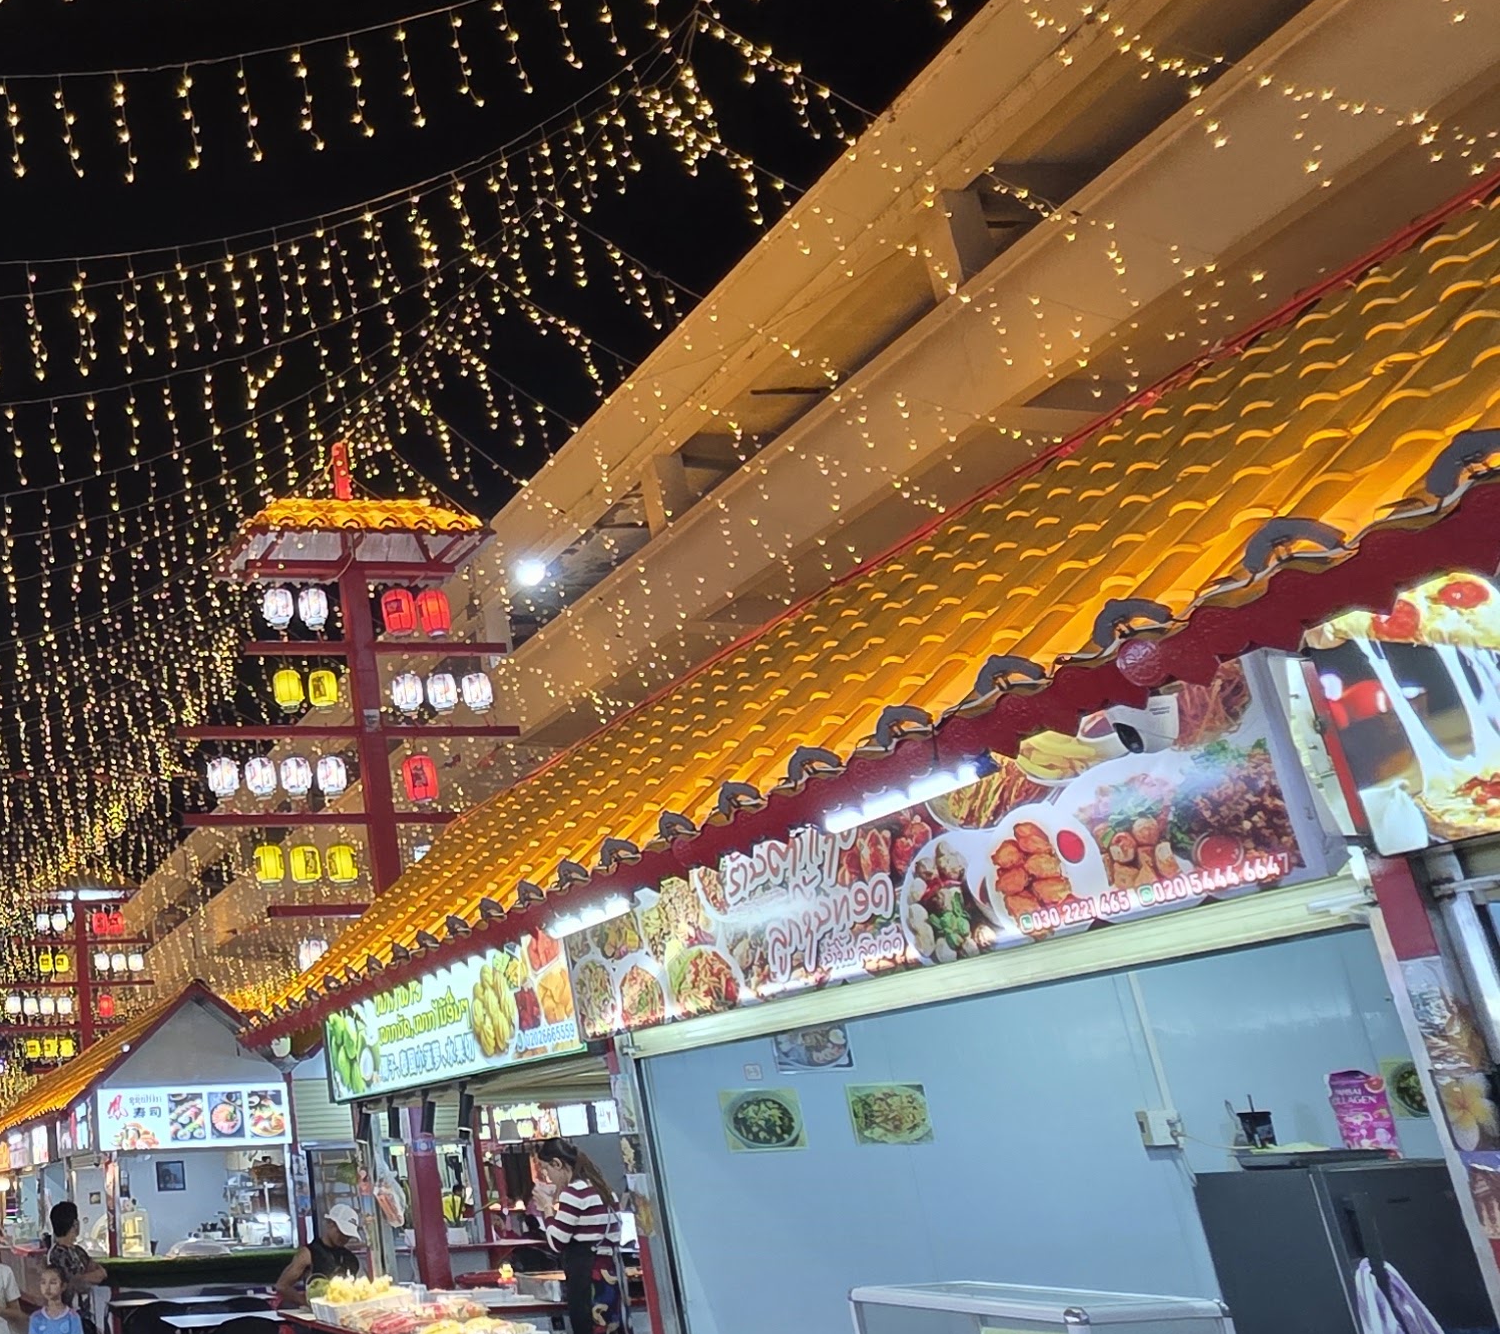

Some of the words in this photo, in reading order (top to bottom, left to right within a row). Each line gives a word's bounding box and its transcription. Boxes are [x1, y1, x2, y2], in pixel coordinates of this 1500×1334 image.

[1032, 910, 1060, 931] 030
[1062, 898, 1097, 924] 2221
[1099, 890, 1130, 916] 465
[1152, 876, 1187, 903] 020
[1190, 864, 1240, 892] 5444
[1243, 853, 1290, 883] 6647
